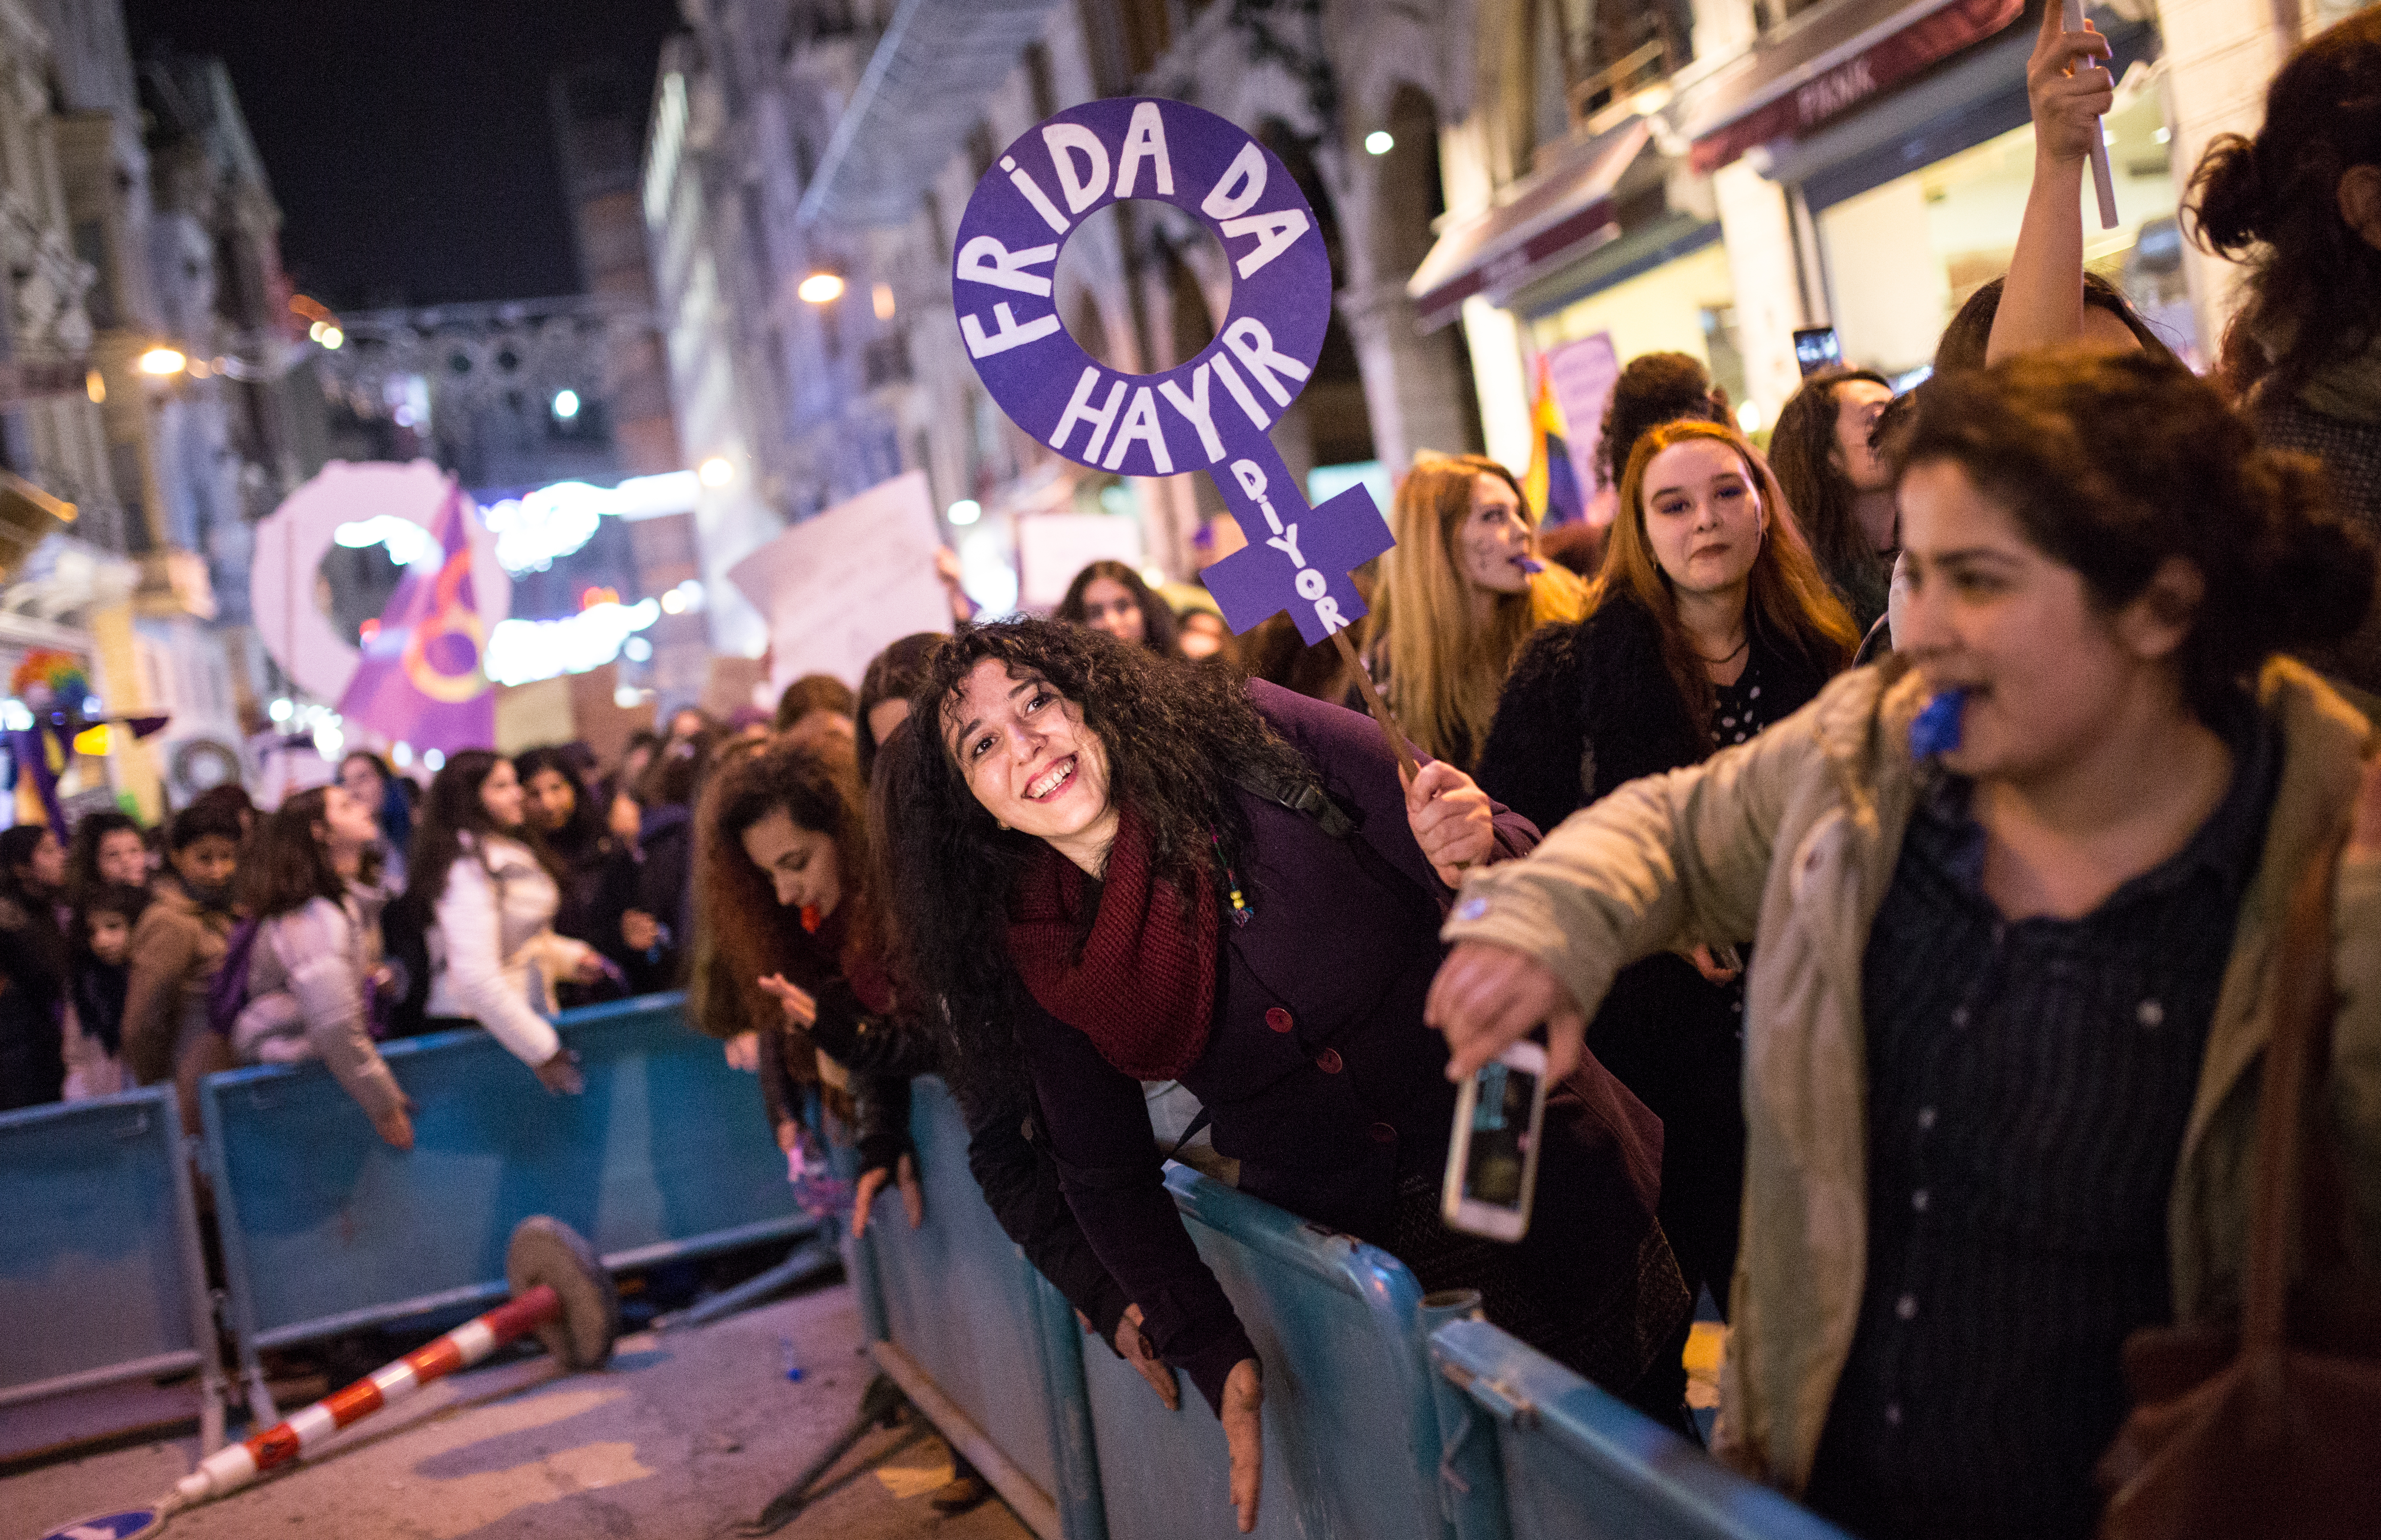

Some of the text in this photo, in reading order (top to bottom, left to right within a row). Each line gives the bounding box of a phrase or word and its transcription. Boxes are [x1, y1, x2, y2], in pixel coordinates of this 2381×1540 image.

[957, 102, 1310, 359] FRİDA DA
[1049, 317, 1310, 473] HAYIR
[1231, 459, 1349, 635] DİYOR
